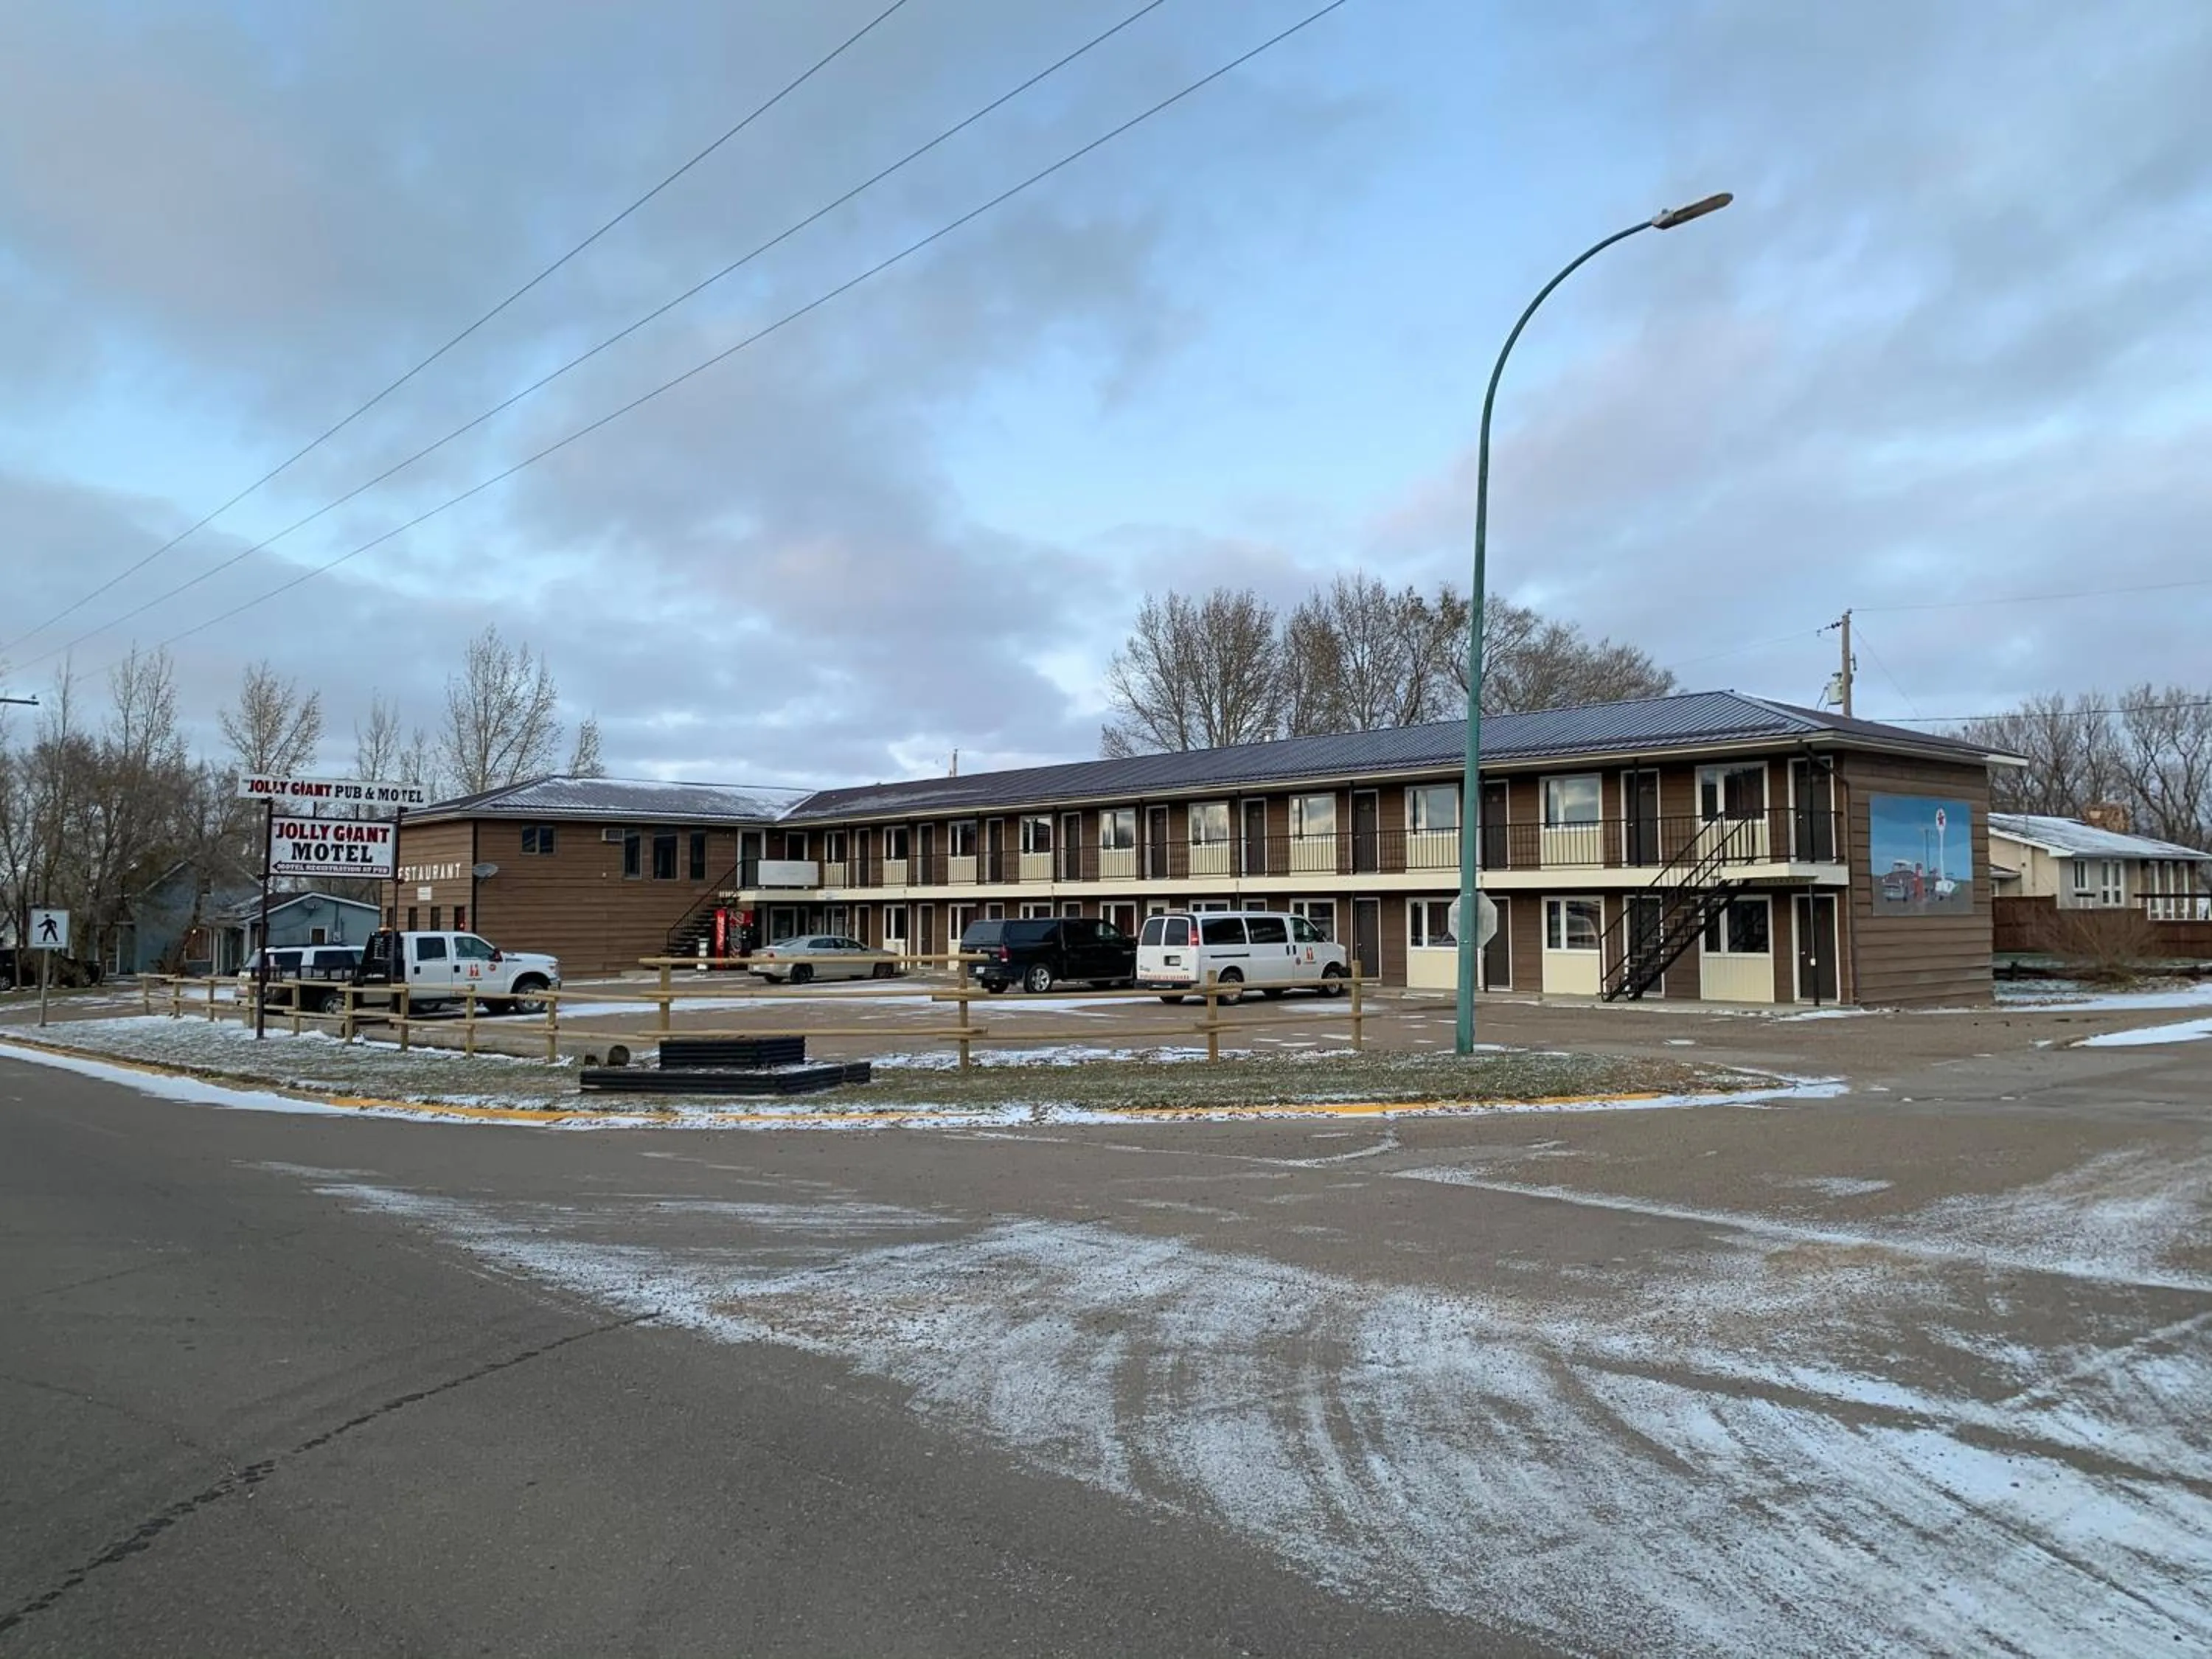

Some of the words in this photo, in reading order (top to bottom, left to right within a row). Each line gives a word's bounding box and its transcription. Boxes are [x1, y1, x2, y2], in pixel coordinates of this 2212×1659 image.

[247, 779, 288, 793] JOLLY
[291, 780, 332, 797] GIANT
[334, 785, 362, 799] PUB
[365, 785, 375, 800] &
[377, 787, 424, 804] MOTEL
[275, 822, 330, 841] JOLLY
[333, 824, 390, 843] GIANT
[291, 842, 372, 863] MOTEL
[397, 863, 461, 882] ESTAURANT
